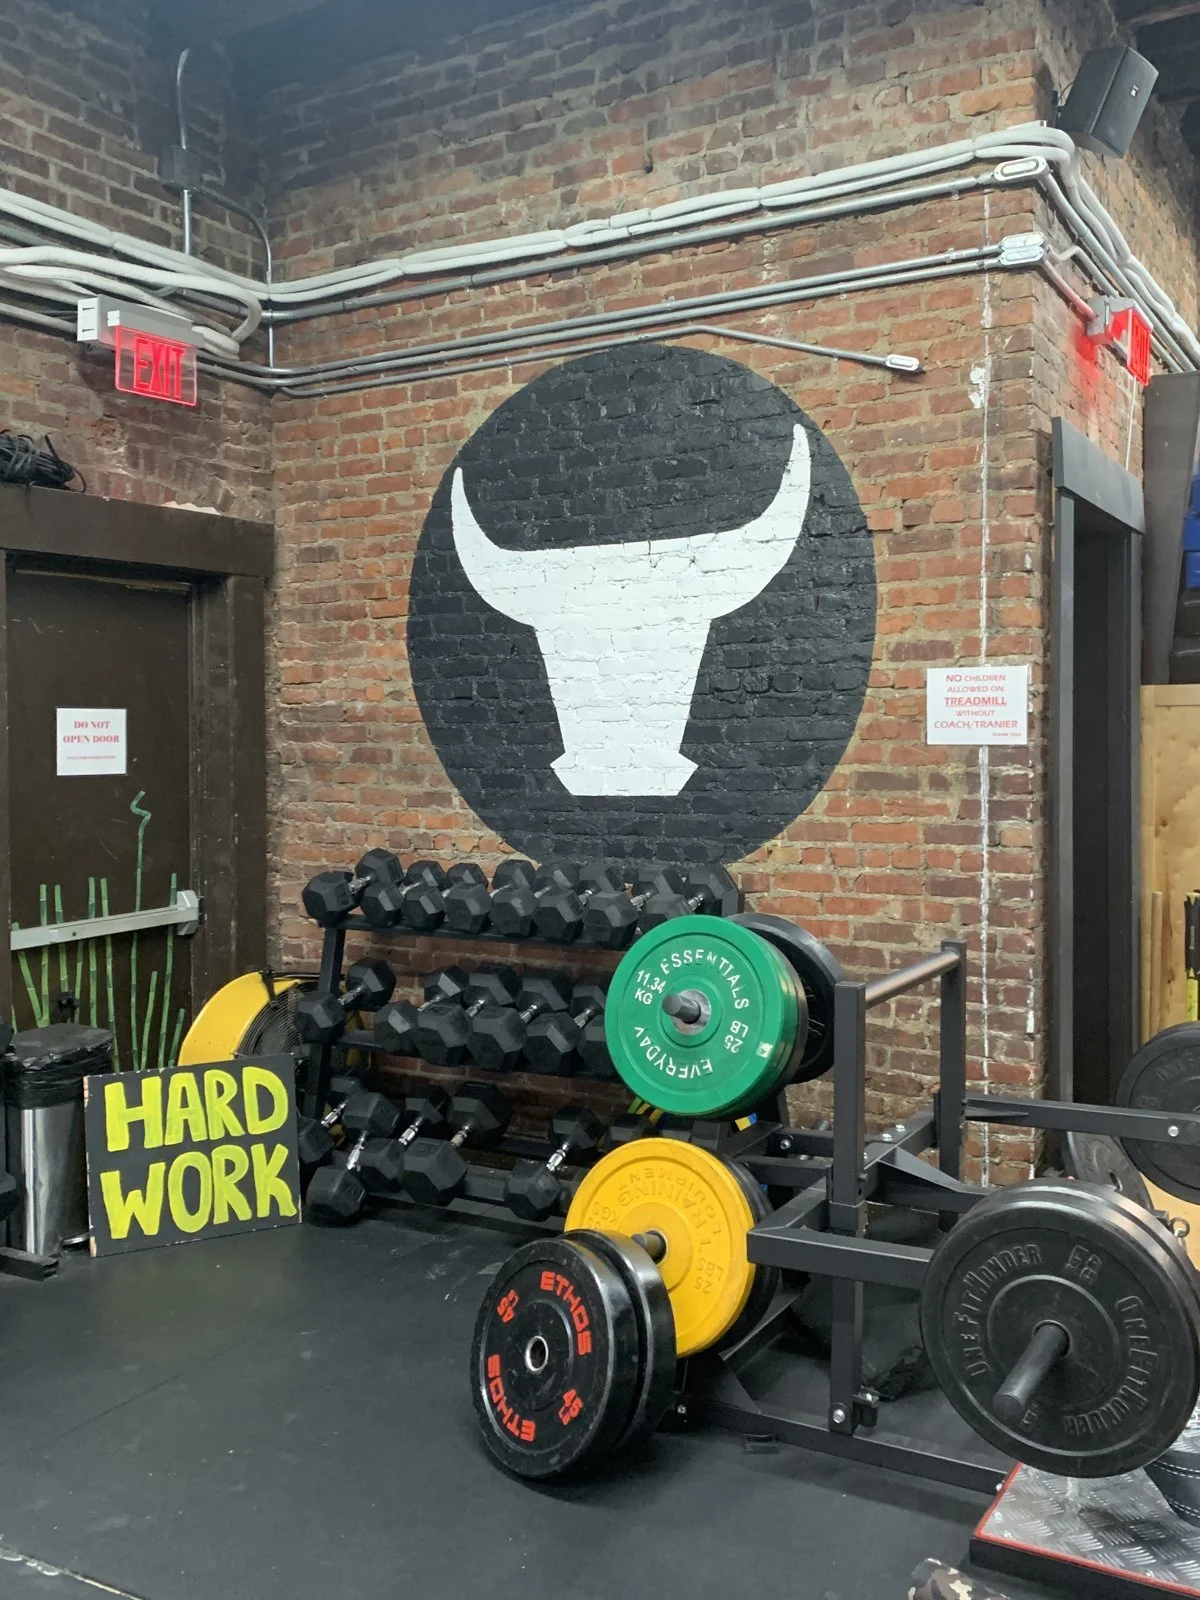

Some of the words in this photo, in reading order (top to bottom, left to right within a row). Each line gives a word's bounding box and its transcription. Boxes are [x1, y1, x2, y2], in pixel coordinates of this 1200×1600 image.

[134, 337, 186, 399] EXIT
[946, 674, 962, 683] NO
[963, 674, 1006, 682] CHILDREN
[946, 685, 989, 693] ALLOWED
[944, 696, 1007, 706] TREADMILL
[955, 709, 996, 717] WITHOUT
[73, 720, 89, 729] DO
[90, 720, 110, 729] NOT
[62, 735, 90, 743] OPEN
[92, 735, 120, 743] DOOR
[636, 969, 667, 994] 11.34
[660, 948, 749, 1010] ESSENTIALS
[634, 987, 653, 1005] KG
[729, 1020, 749, 1038] LB
[634, 1026, 713, 1079] EVERYDAY
[723, 1035, 744, 1054] 25
[105, 1066, 289, 1152] HARD
[100, 1143, 297, 1240] WORK
[496, 1297, 515, 1323] 45
[540, 1270, 592, 1356] ETHOS
[487, 1353, 536, 1442] ETHOS
[562, 1388, 584, 1418] 45
